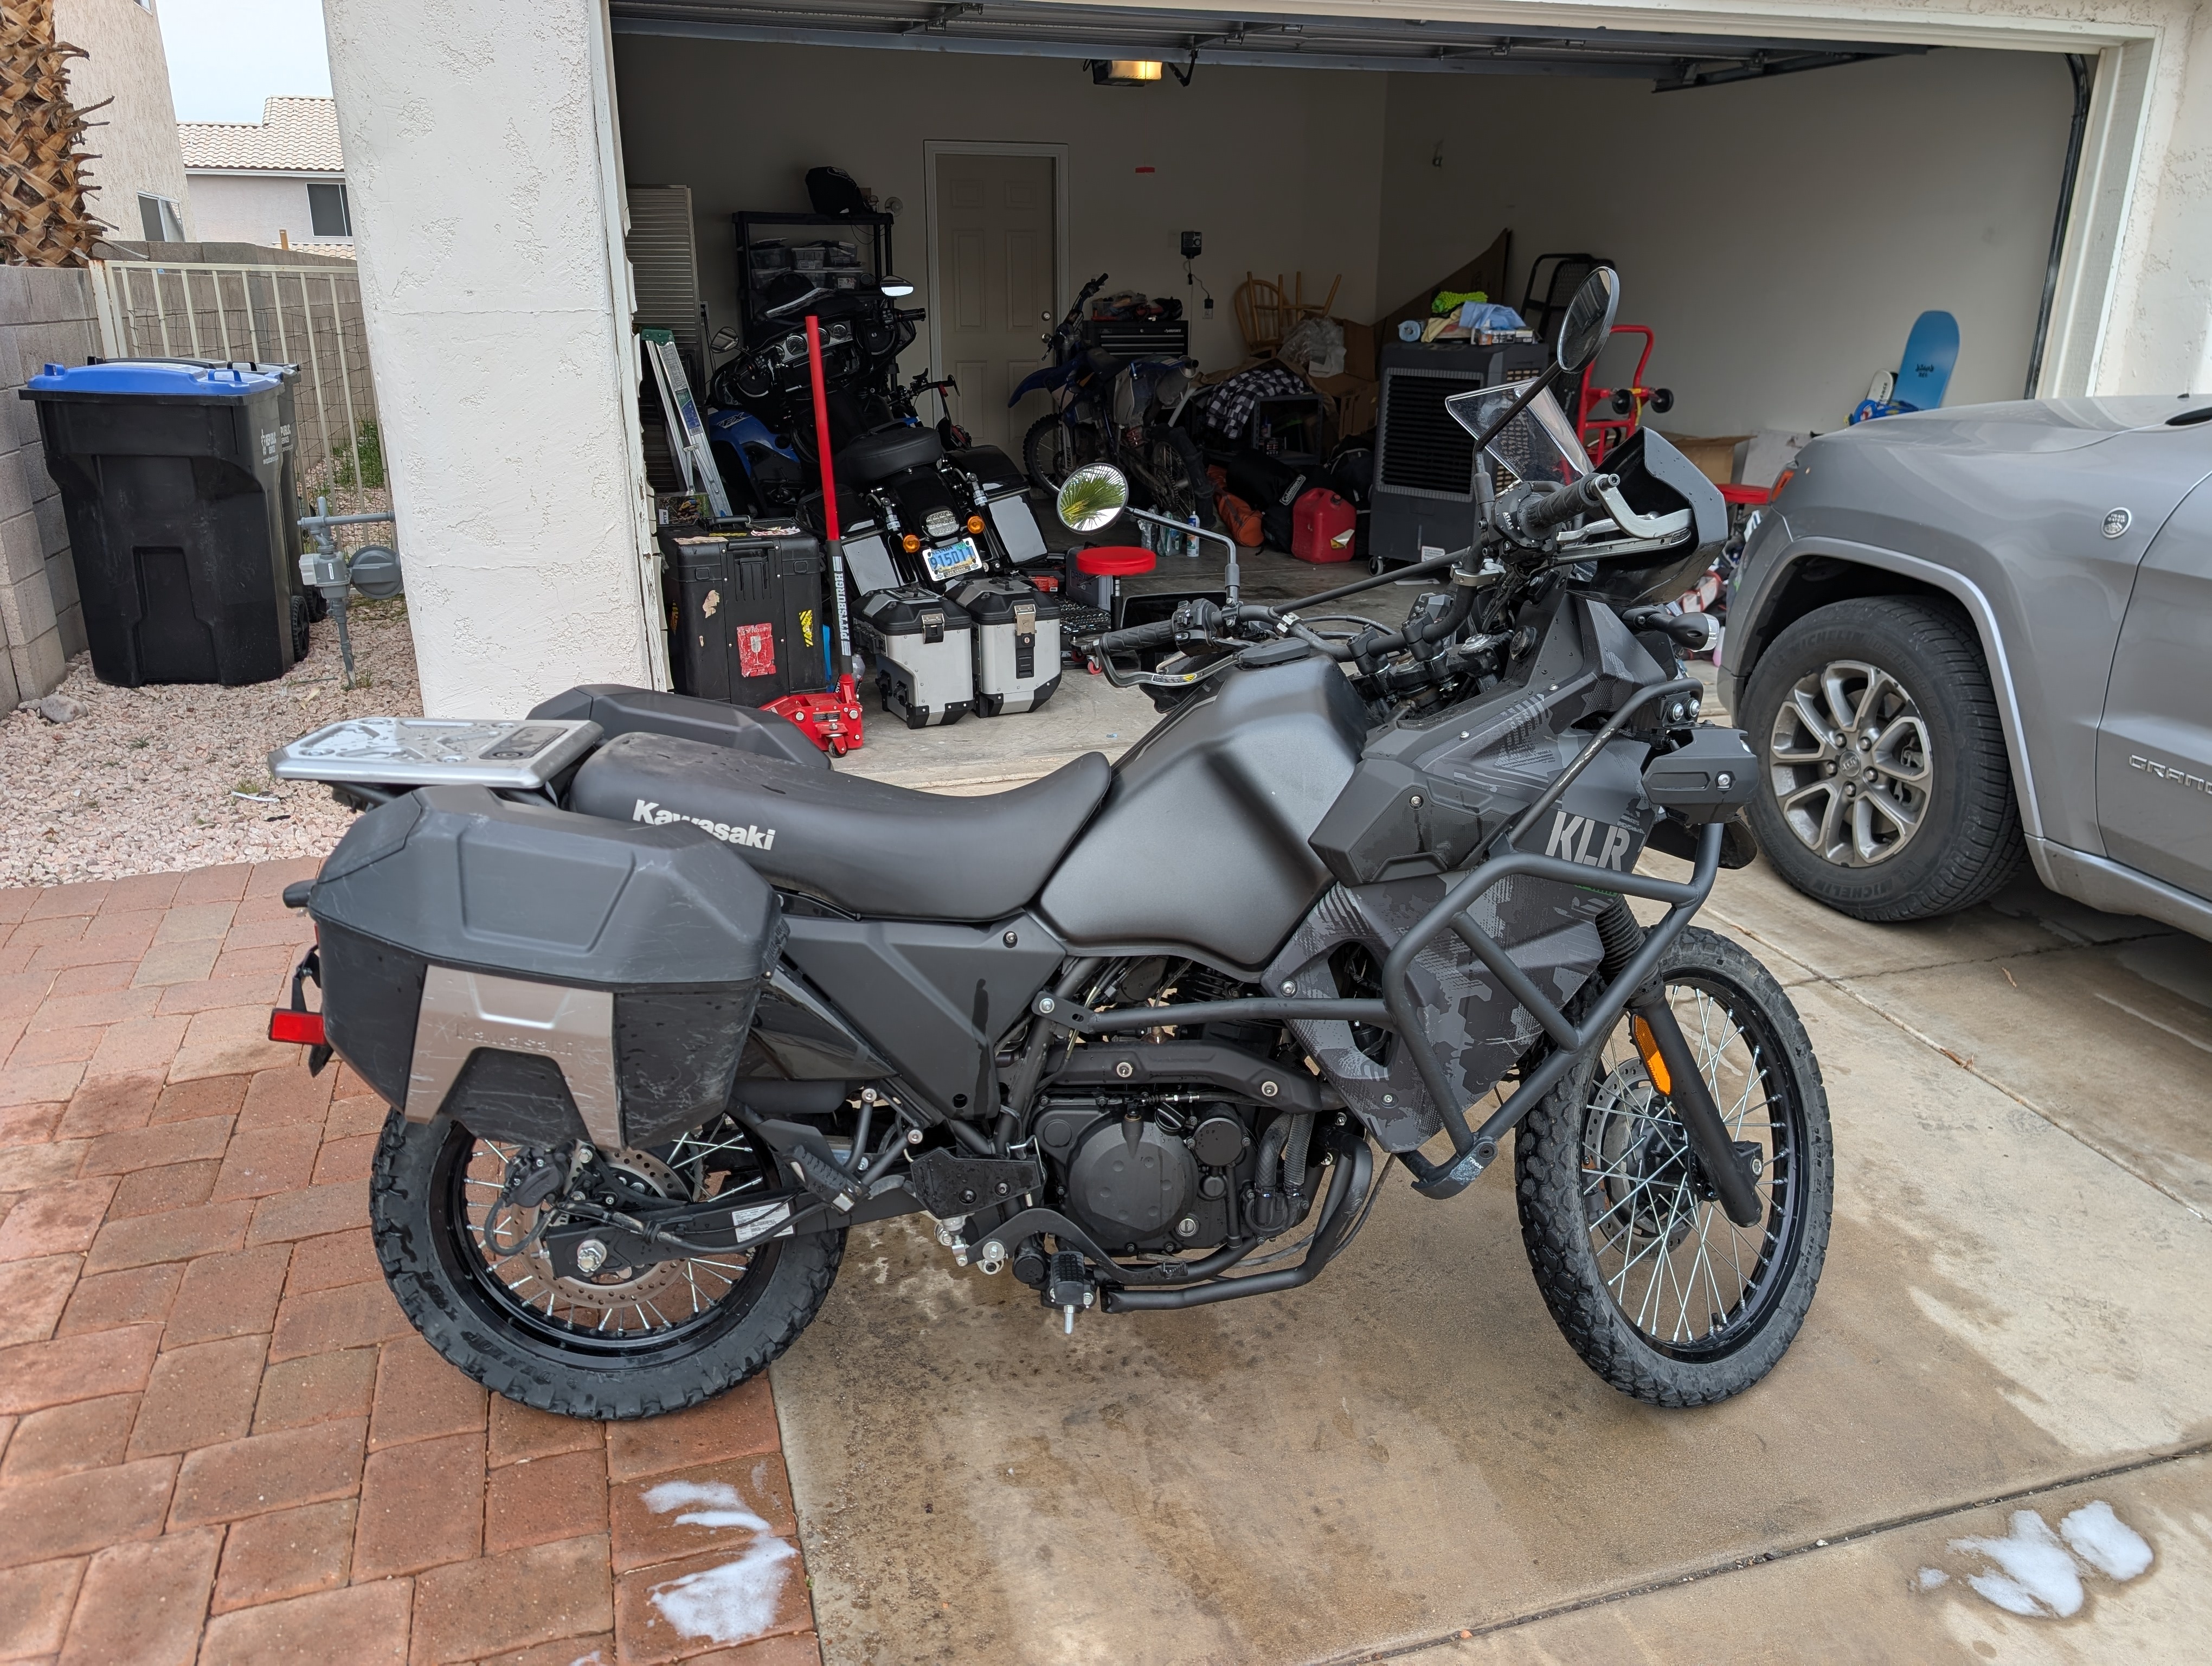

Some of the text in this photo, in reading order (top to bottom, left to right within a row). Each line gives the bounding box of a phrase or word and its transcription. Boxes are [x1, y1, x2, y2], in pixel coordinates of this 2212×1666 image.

[1282, 479, 1300, 502] Coleman
[1503, 512, 1514, 530] ATLAS
[931, 546, 954, 555] NEVADA
[834, 573, 850, 640] PITTSBURGH
[1791, 630, 1864, 651] MICHELIN
[1874, 640, 1924, 688] DEFENDER
[633, 799, 776, 850] Kaasaki
[1545, 811, 1630, 872] KLR
[1814, 877, 1893, 898] MICHELIN
[456, 1023, 573, 1055] Kawasaki
[460, 1331, 555, 1385] DUNLOP
